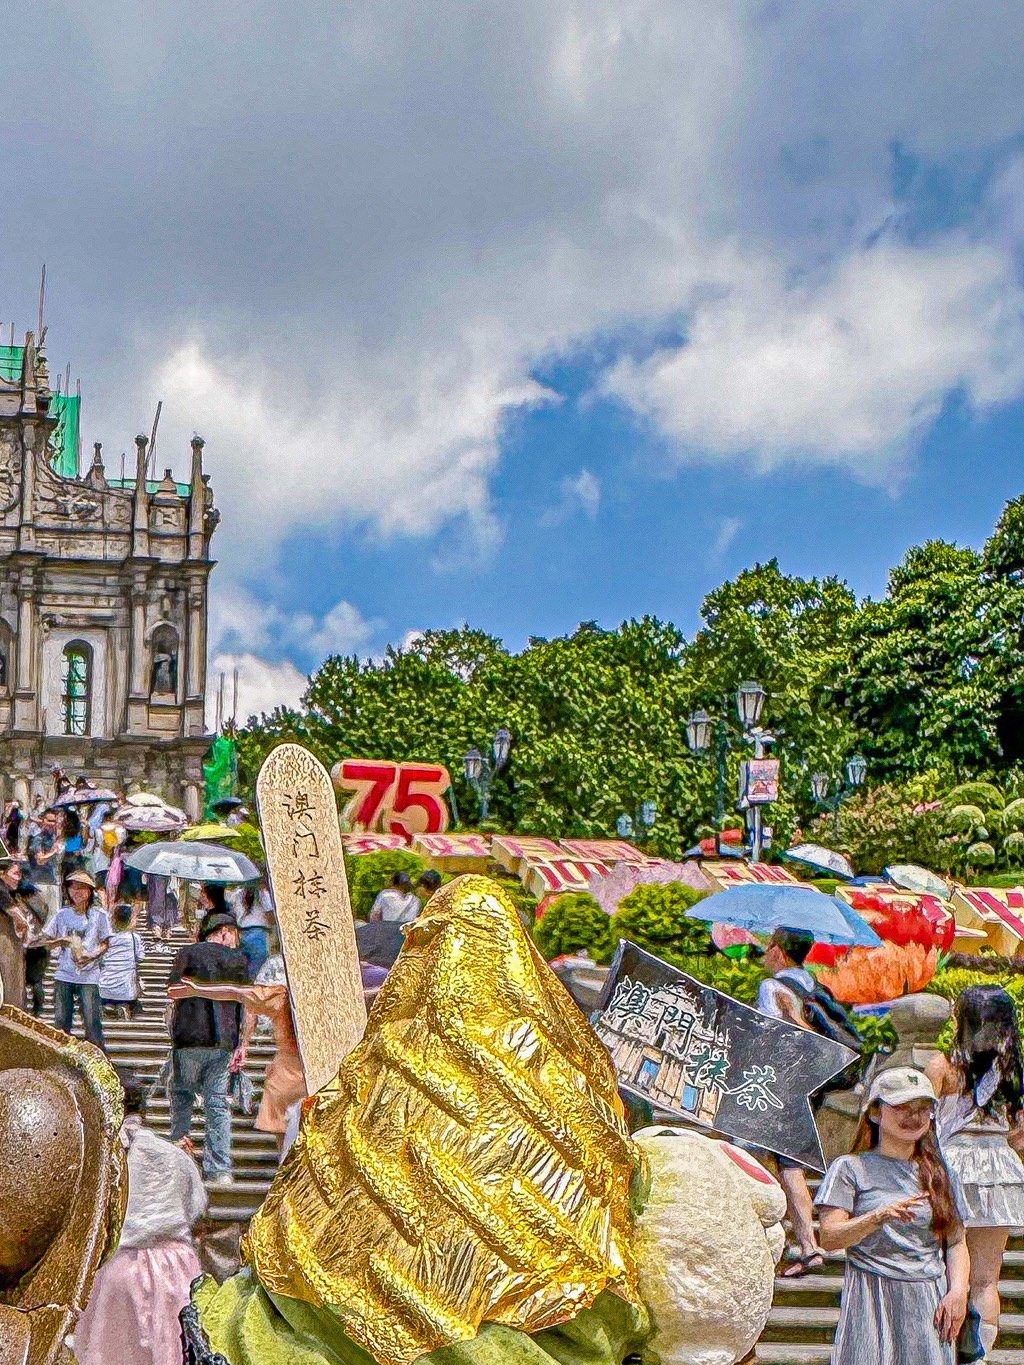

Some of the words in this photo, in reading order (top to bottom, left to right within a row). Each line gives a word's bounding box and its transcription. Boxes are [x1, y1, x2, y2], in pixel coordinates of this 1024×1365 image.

[338, 761, 448, 847] 75
[609, 975, 784, 1112] 澳門抹茶
